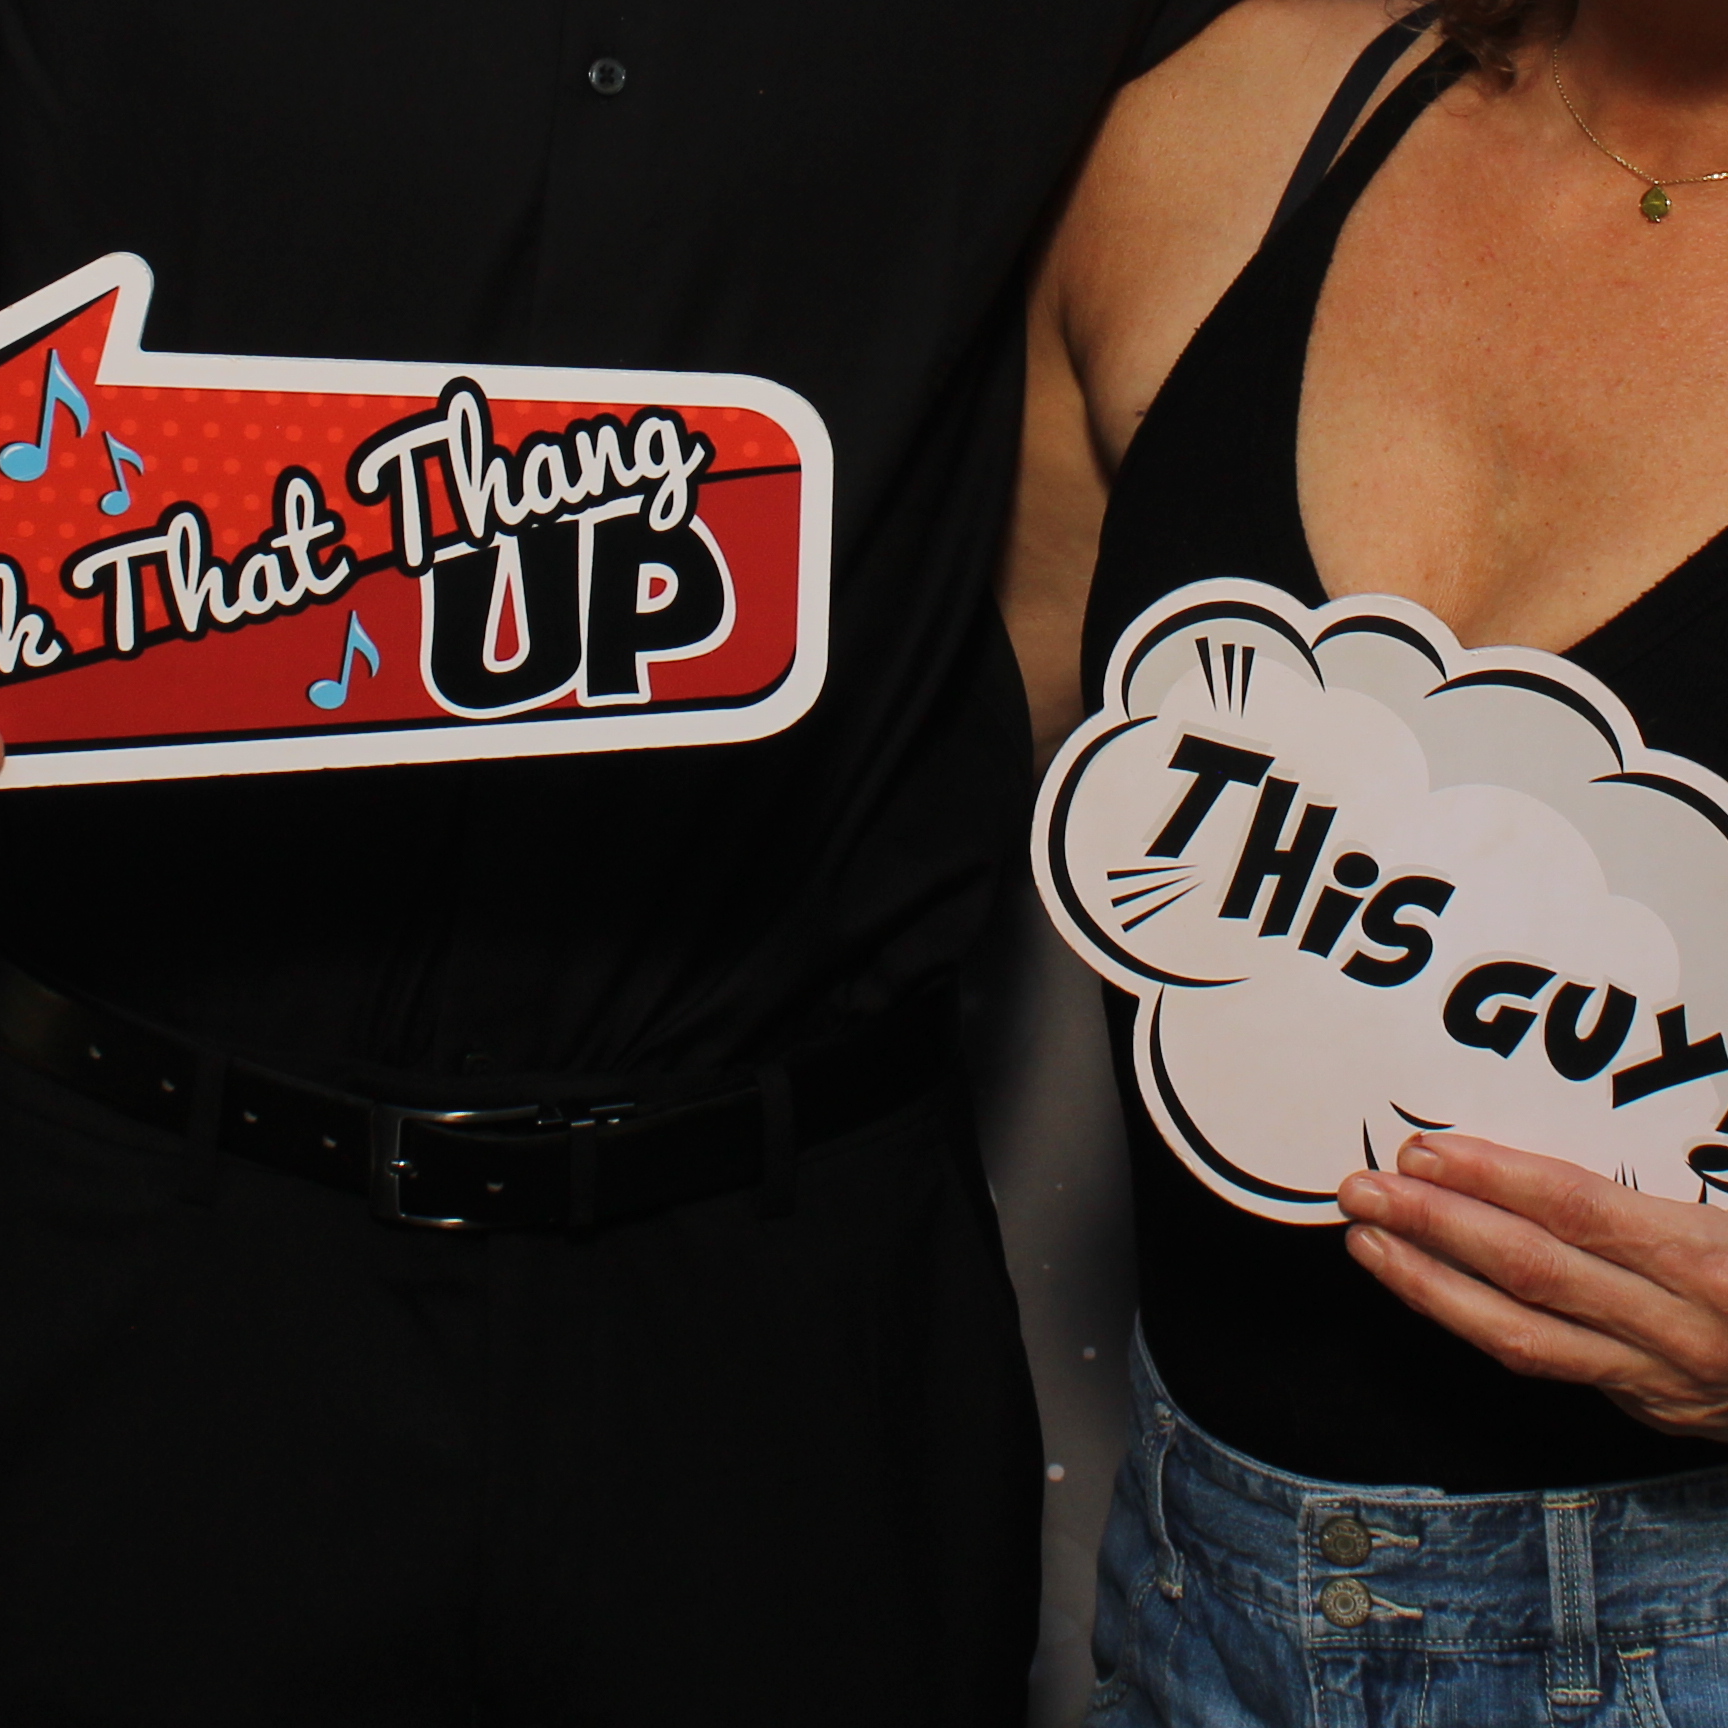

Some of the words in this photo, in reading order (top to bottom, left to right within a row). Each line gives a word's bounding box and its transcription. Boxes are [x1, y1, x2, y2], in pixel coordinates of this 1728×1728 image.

[72, 478, 349, 652] That
[359, 391, 704, 566] Thang
[419, 495, 737, 719] UP
